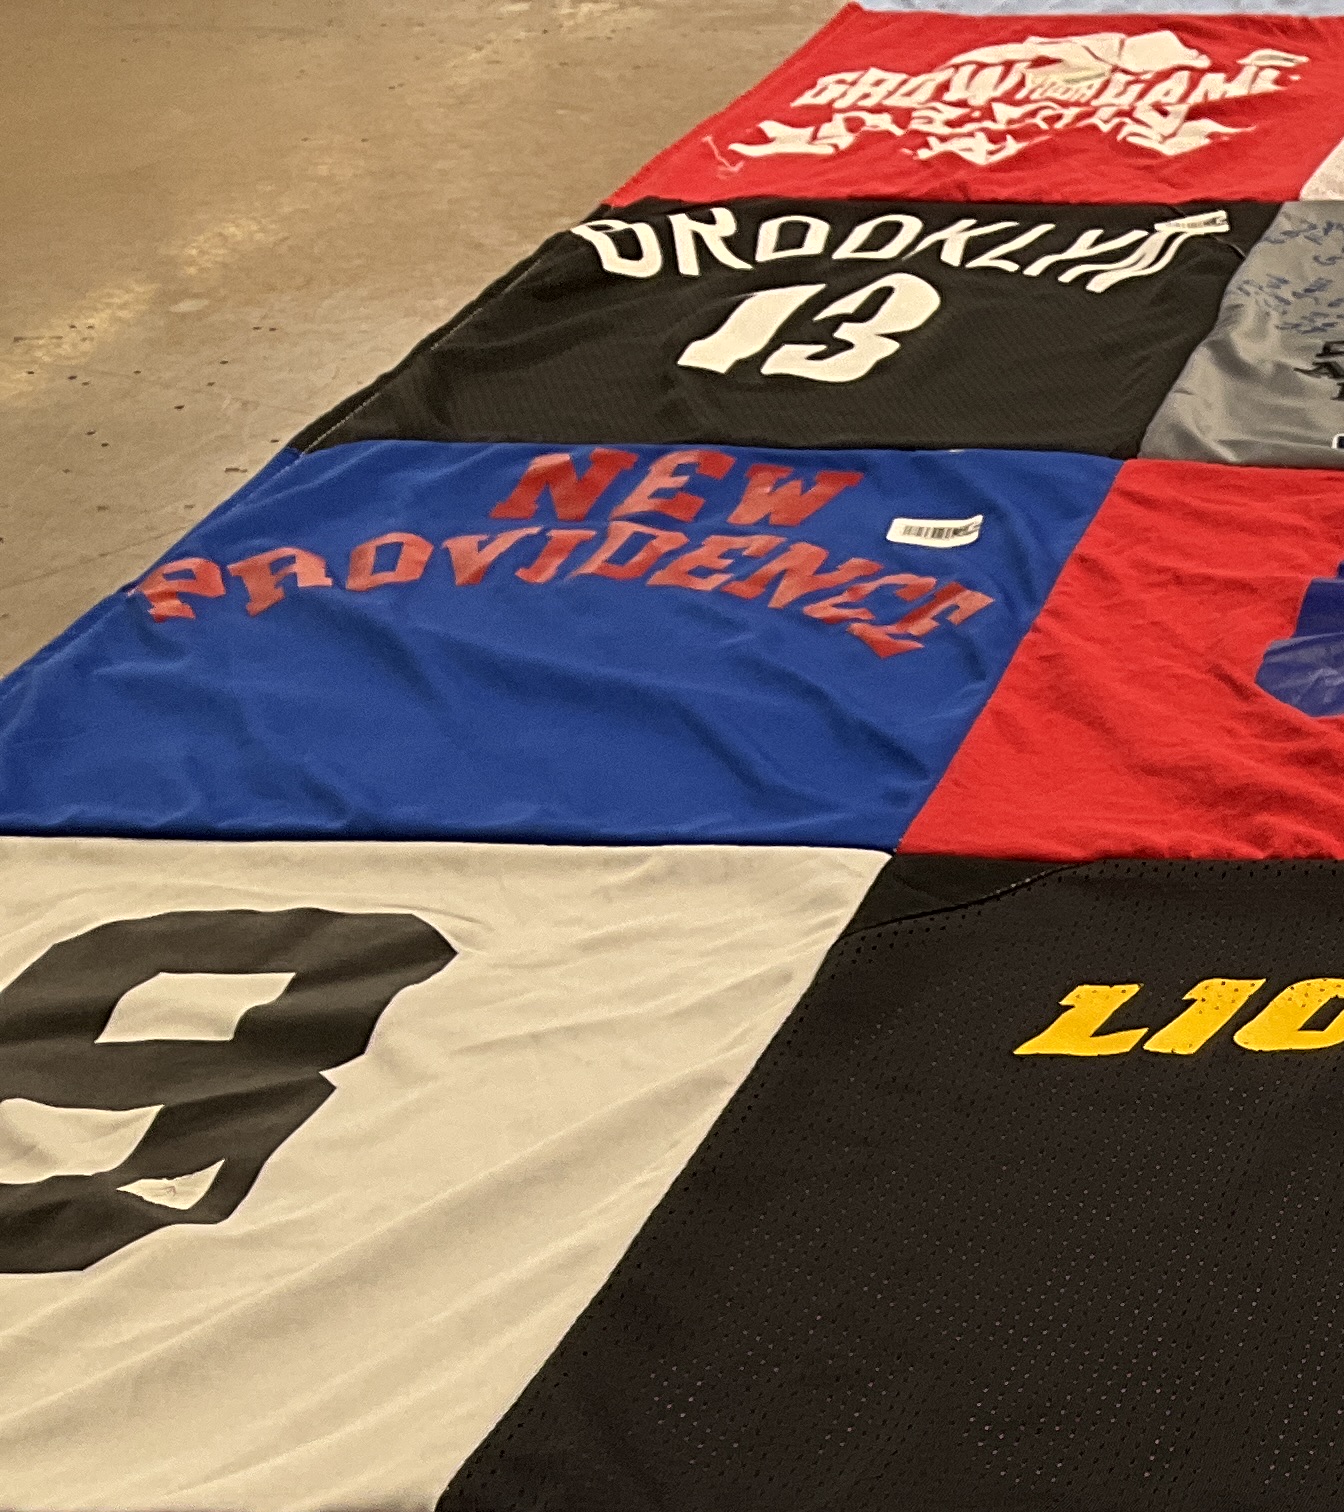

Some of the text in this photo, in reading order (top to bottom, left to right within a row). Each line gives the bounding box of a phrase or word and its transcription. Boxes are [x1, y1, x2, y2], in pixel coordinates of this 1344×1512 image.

[569, 206, 1206, 293] BROOKLYN
[677, 272, 942, 382] 13
[489, 447, 862, 527] NEW
[128, 519, 995, 660] PROVIDENCE
